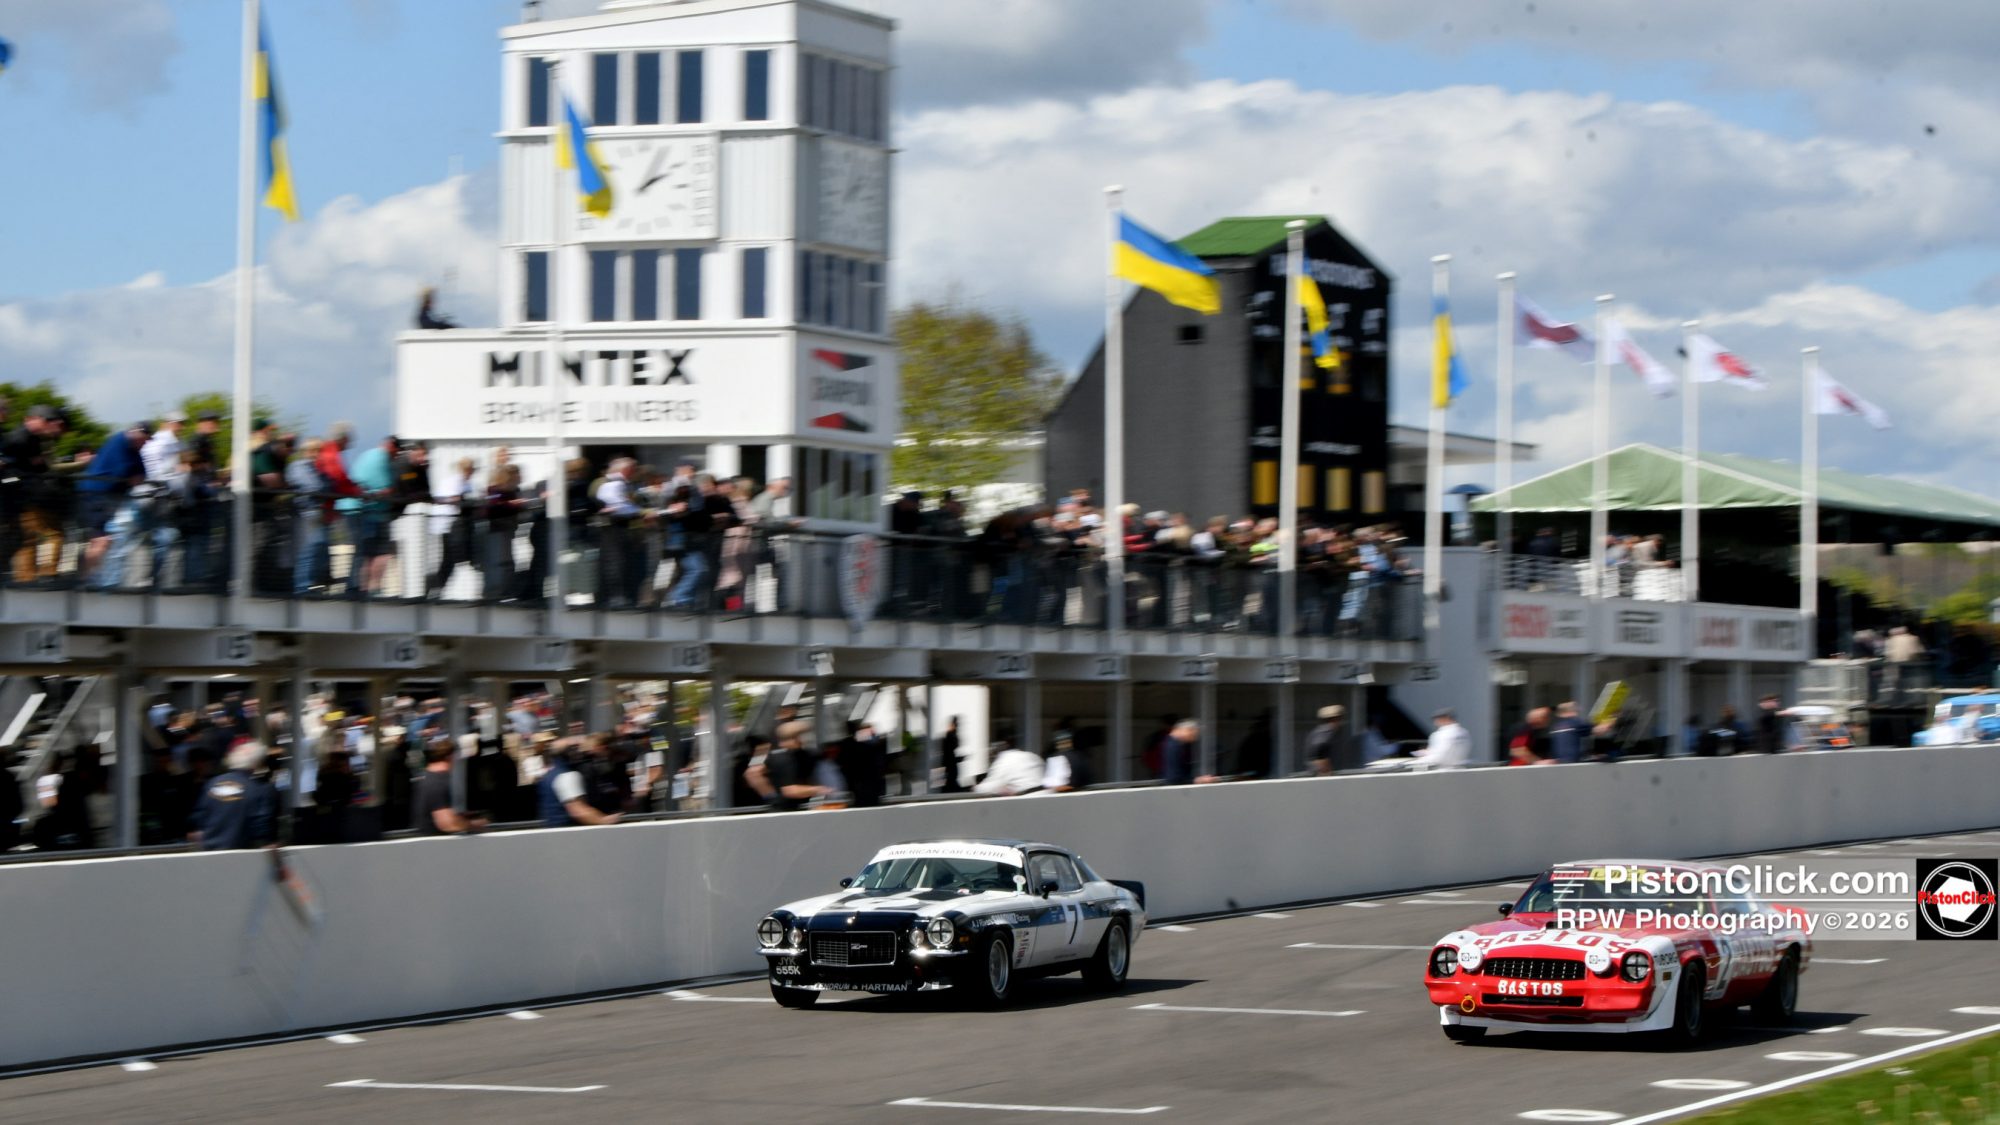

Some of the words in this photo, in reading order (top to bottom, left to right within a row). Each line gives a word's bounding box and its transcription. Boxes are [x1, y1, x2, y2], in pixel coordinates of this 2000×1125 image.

[482, 349, 699, 387] MINTEX
[217, 634, 254, 659] 15
[1066, 904, 1078, 945] 7
[1473, 930, 1633, 954] BASTOS
[776, 966, 801, 975] 555K
[778, 957, 797, 966] JYK
[862, 983, 908, 992] HARTMAN
[1498, 979, 1563, 996] BASTOS
